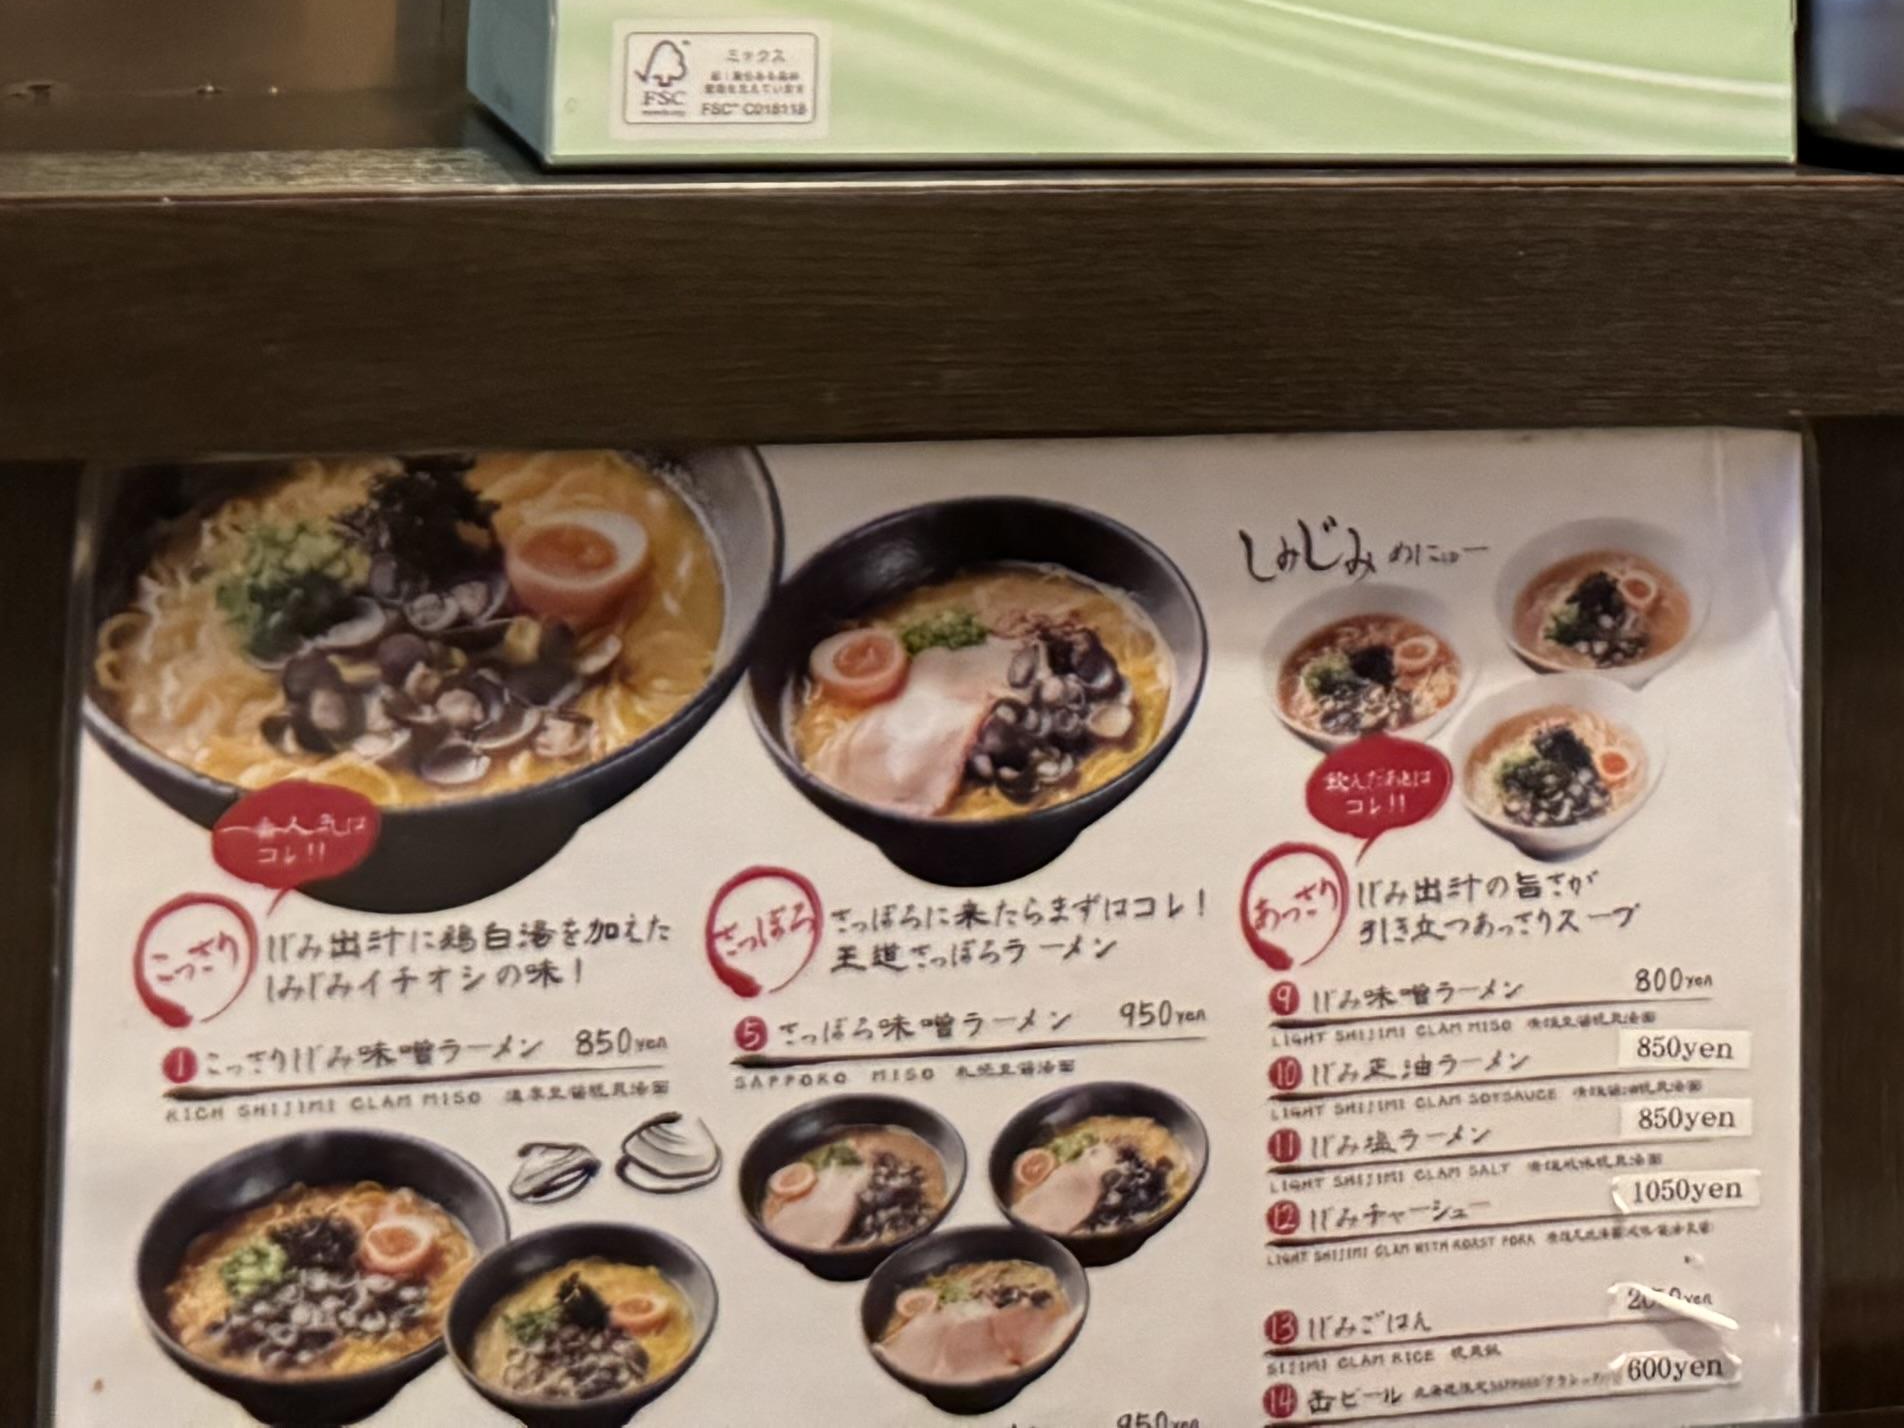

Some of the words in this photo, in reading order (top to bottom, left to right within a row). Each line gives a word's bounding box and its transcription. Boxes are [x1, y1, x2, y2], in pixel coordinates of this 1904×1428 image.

[726, 49, 787, 64] ミックス
[641, 90, 685, 107] FSC
[1252, 876, 1340, 932] あっさり
[1416, 1022, 1463, 1039] CLAM
[1467, 1018, 1513, 1035] MISO
[1636, 1035, 1735, 1063] 850yen
[733, 1070, 850, 1092] SAPPORO
[870, 1066, 936, 1084] MISO
[164, 1103, 225, 1125] RICH
[237, 1097, 336, 1120] SHIJIMI
[349, 1094, 415, 1113] CLAM
[422, 1090, 482, 1108] MISO
[1270, 1101, 1324, 1121] LIGHT
[1415, 1093, 1462, 1111] CLAM
[1637, 1104, 1737, 1132] 850yen
[1270, 1174, 1326, 1194] LIGHT
[1414, 1166, 1462, 1184] CLAM
[1469, 1160, 1513, 1178] SALT
[1632, 1179, 1744, 1206] 1050yen
[1337, 1353, 1386, 1371] CLAM
[1391, 1350, 1436, 1366] RICE
[1627, 1357, 1724, 1382] 600yen
